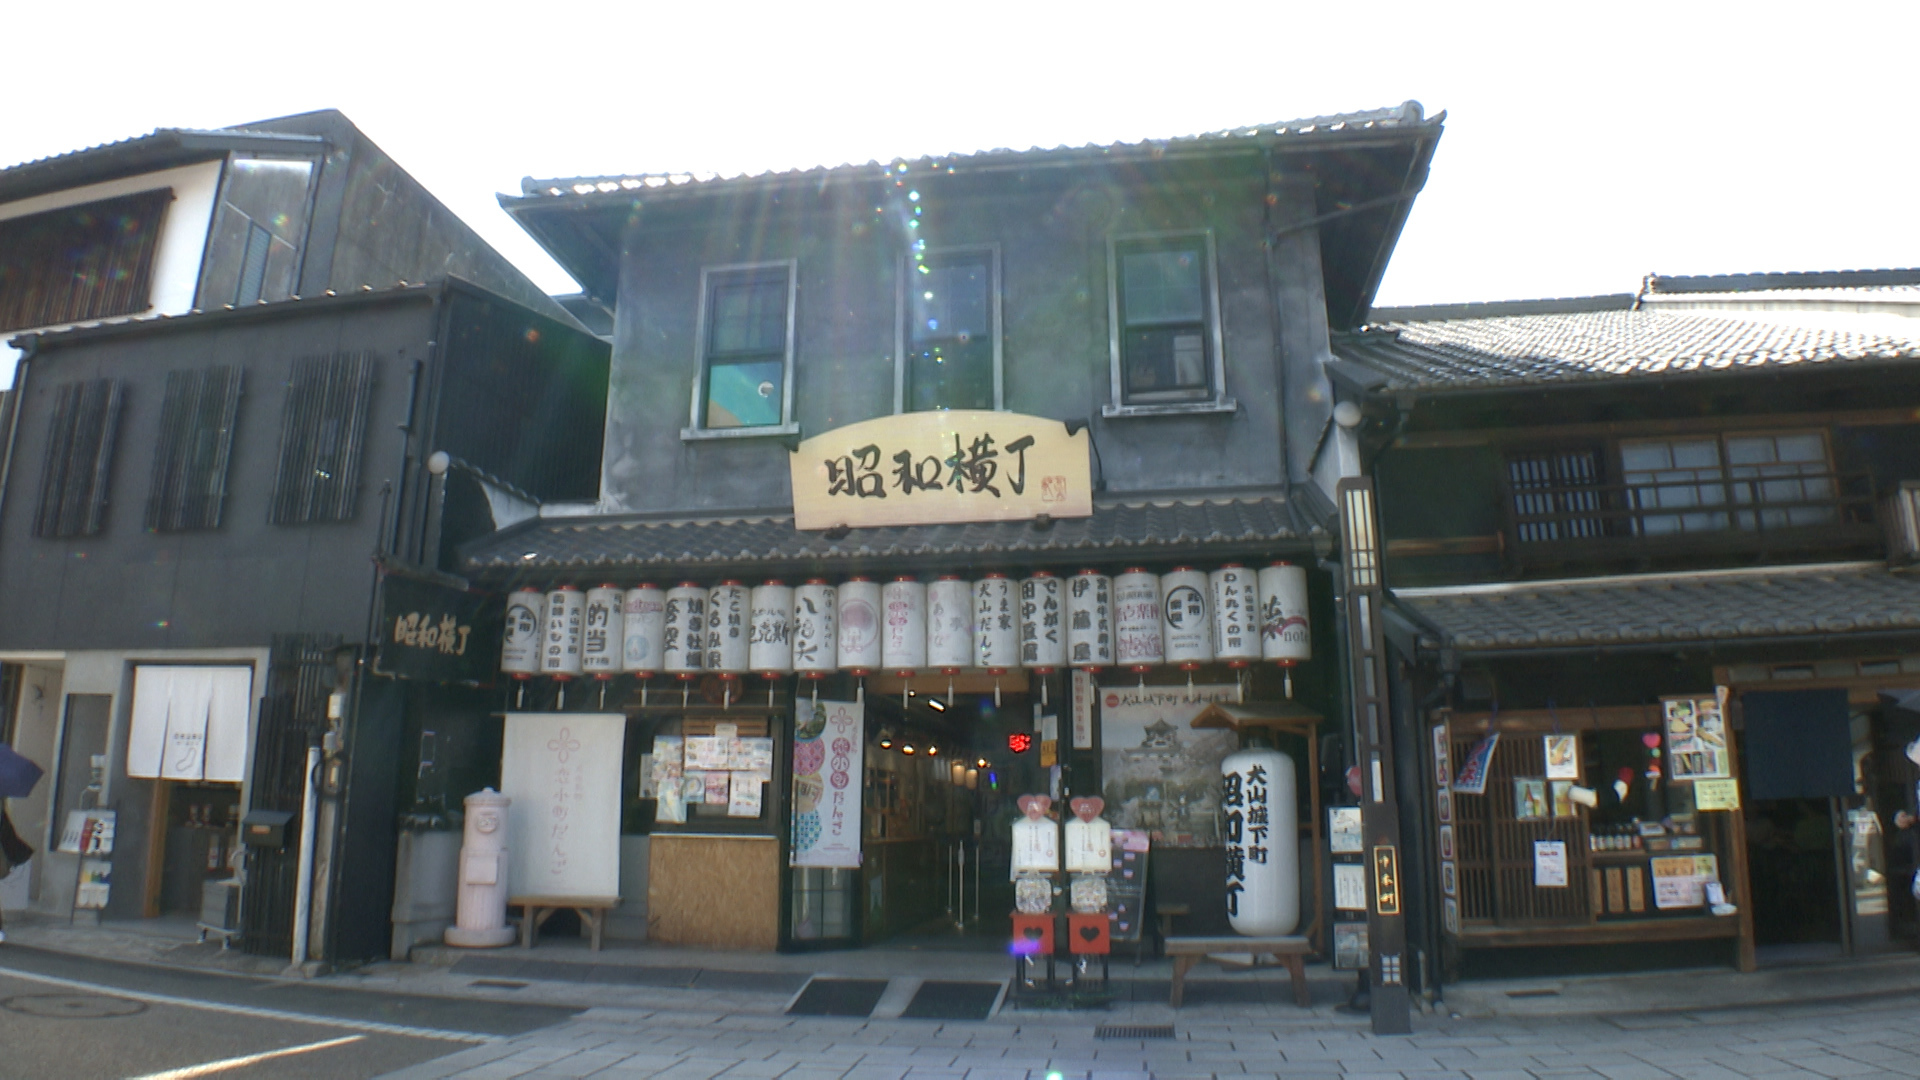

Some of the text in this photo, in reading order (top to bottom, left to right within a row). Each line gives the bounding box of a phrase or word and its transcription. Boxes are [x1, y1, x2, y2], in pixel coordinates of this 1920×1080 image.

[823, 432, 1036, 499] 昭和横丁
[393, 611, 472, 656] 昭和横丁
[1246, 763, 1268, 864] 犬山城下町
